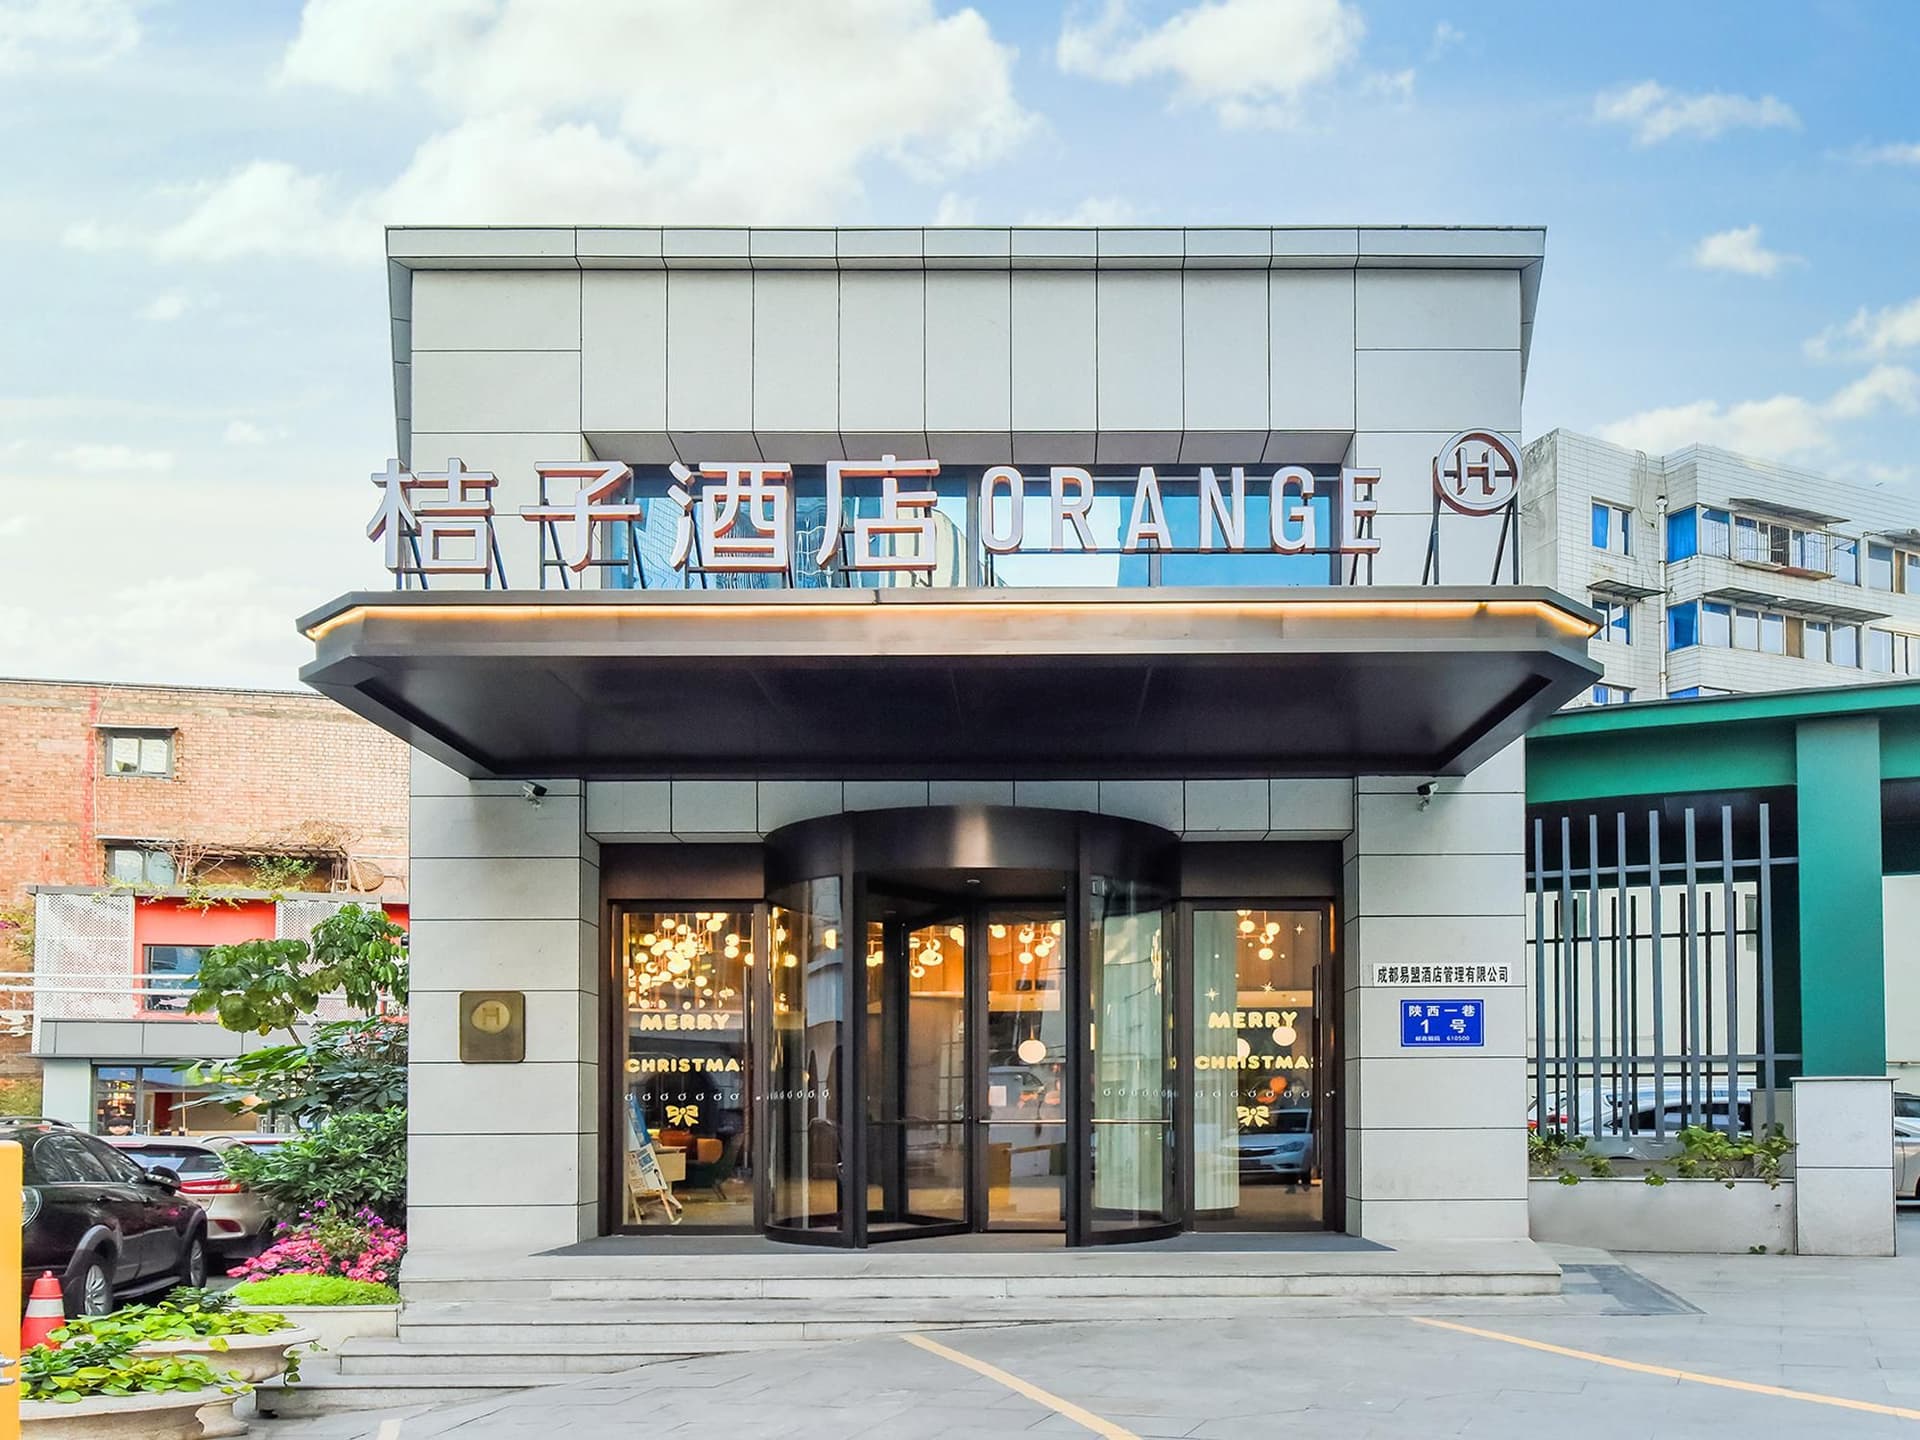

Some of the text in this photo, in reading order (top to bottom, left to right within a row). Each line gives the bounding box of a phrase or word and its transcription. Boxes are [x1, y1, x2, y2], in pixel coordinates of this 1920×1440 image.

[366, 455, 1381, 573] 桔子酒店 ORANGE
[1377, 966, 1508, 983] 成都易盟酒店管理有限公司
[1408, 1005, 1476, 1017] 陕西一巷
[640, 1014, 730, 1031] MERRY
[1208, 1011, 1298, 1029] MERRY
[624, 1058, 745, 1073] CHRISTMA
[1194, 1055, 1314, 1070] CHRISTMA
